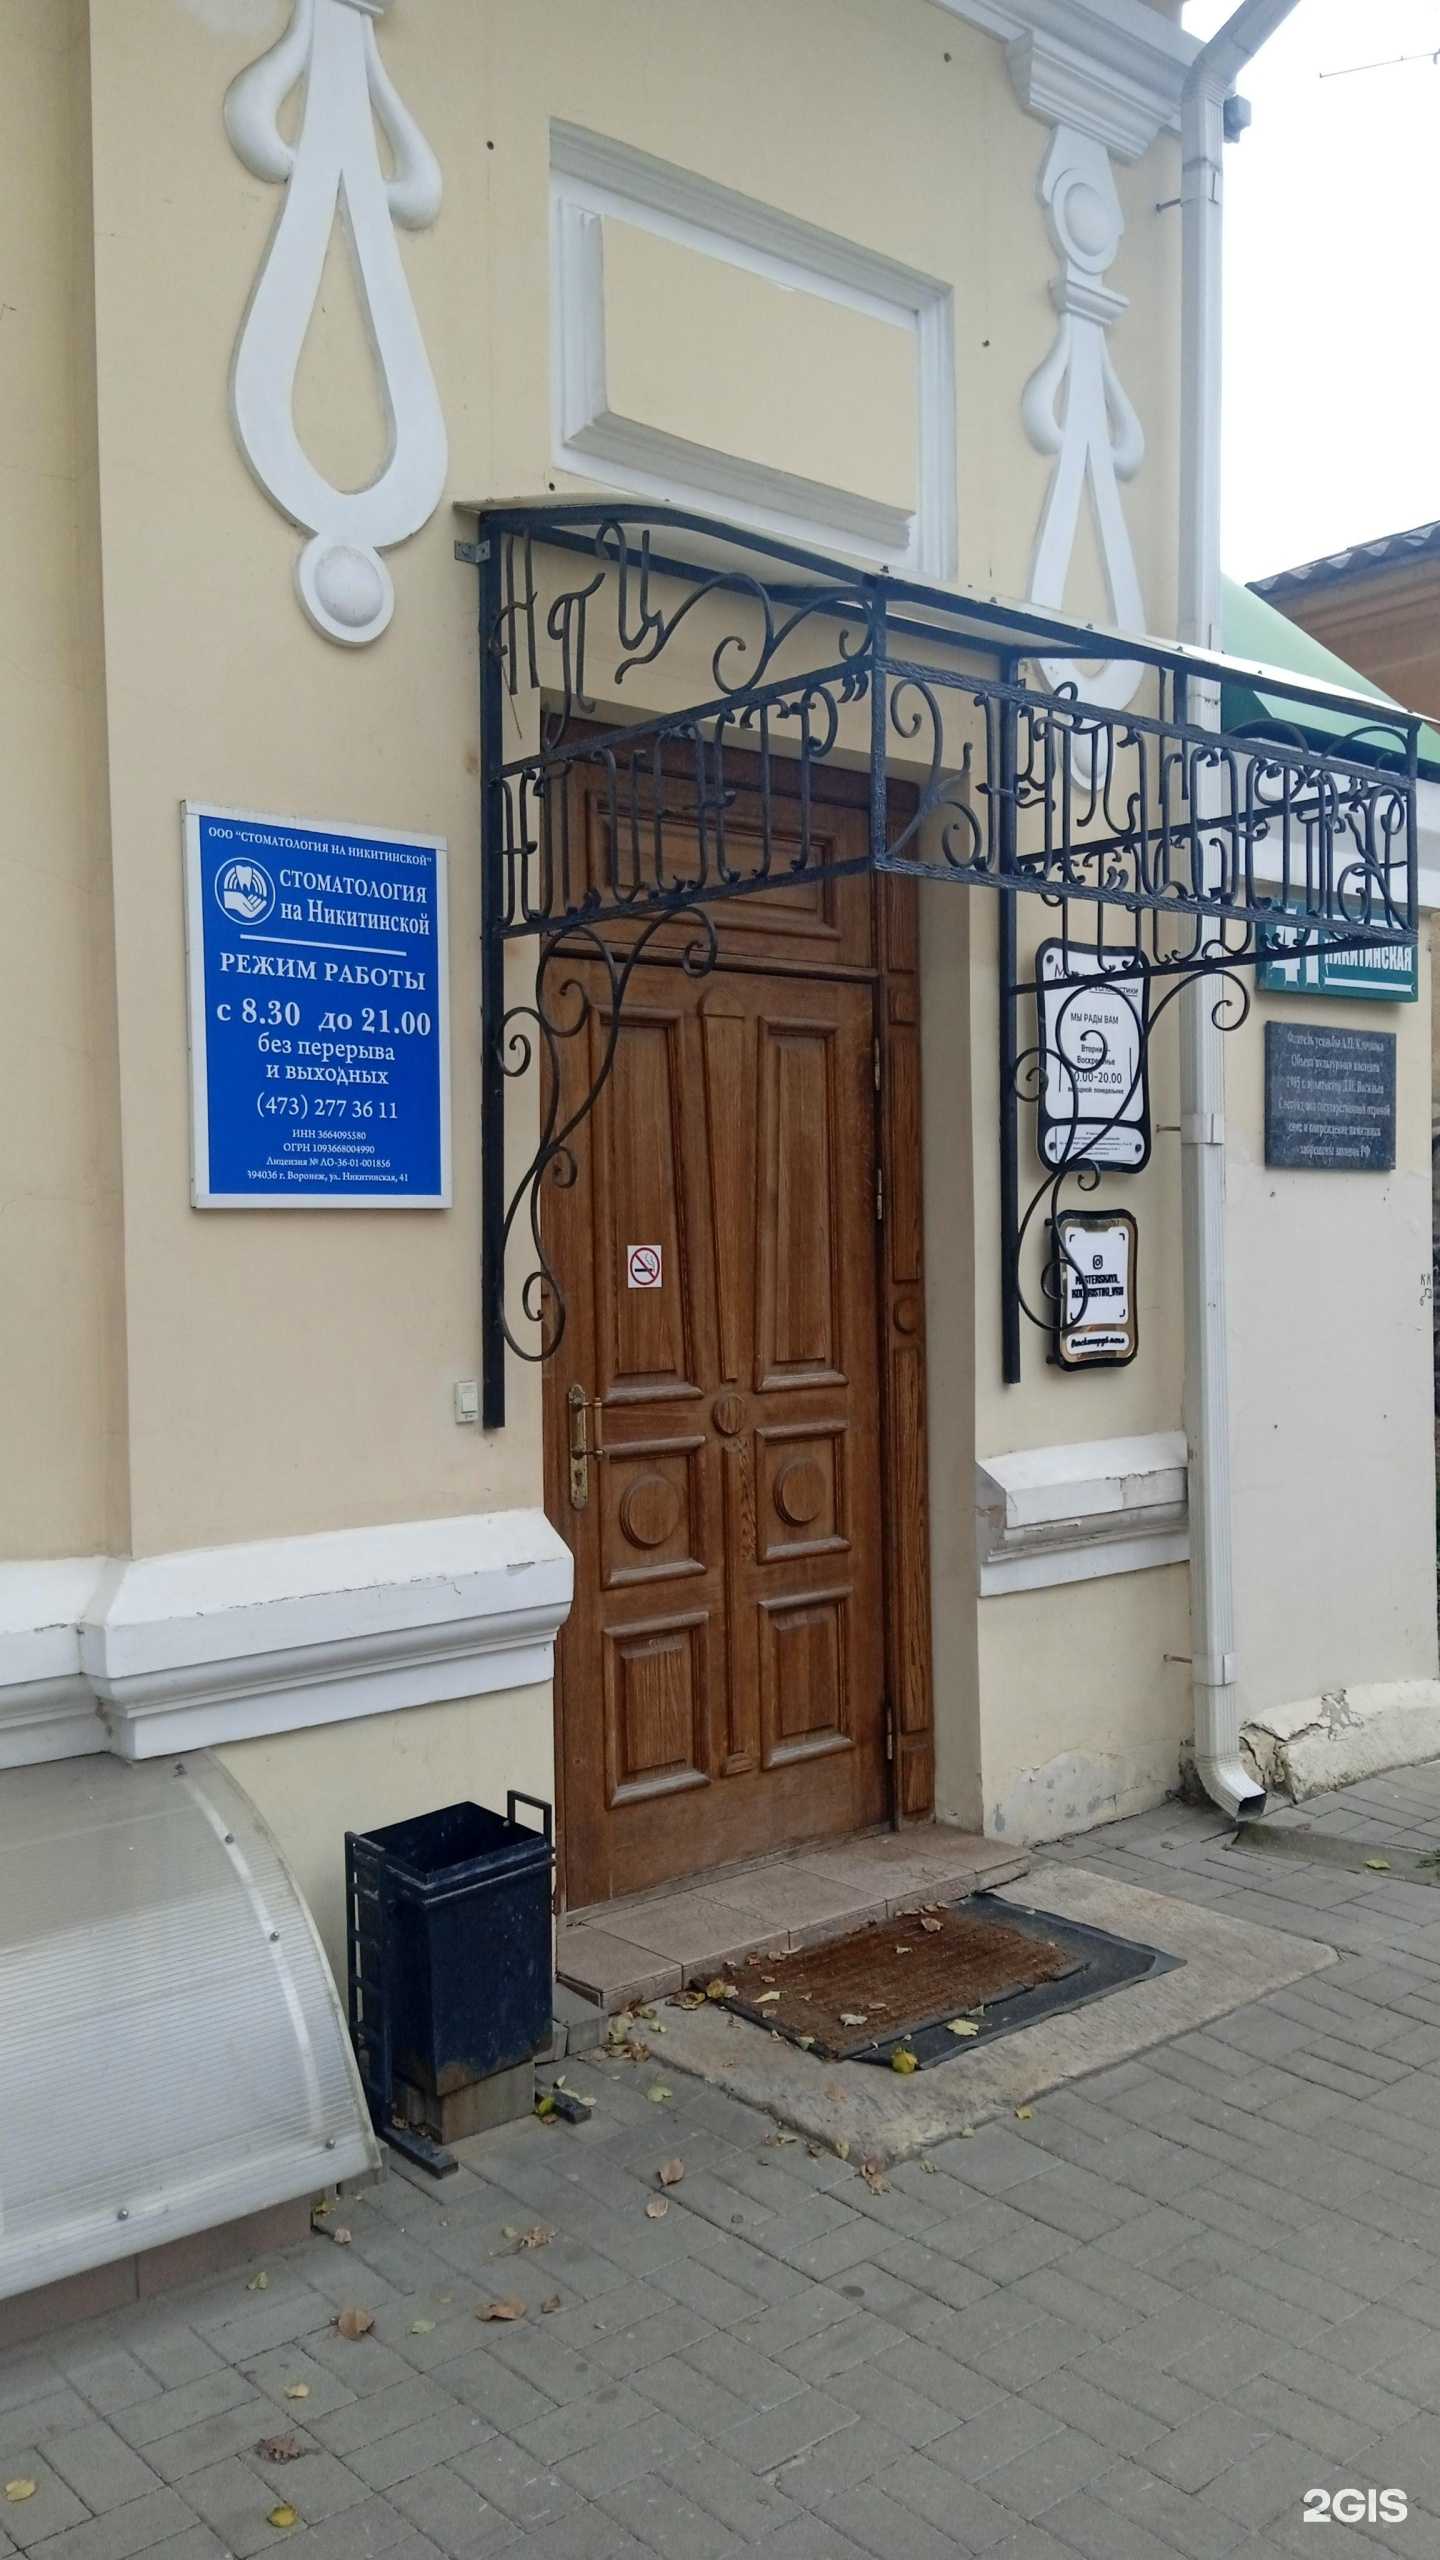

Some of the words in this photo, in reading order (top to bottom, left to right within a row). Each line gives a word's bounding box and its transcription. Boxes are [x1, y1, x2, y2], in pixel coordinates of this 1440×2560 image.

[208, 826, 234, 840] ООО
[331, 844, 346, 856] НА
[279, 868, 427, 903] СТОМАТОЛОГИЯ
[280, 902, 303, 921] на
[306, 899, 431, 936] Никитинской
[219, 952, 318, 981] РЕЖИМ
[323, 962, 426, 991] РАБОТЫ
[241, 997, 301, 1027] 8.30
[318, 1011, 353, 1033] до
[361, 1007, 432, 1036] 21.00
[1070, 1013, 1083, 1023] МЫ
[1084, 1014, 1103, 1025] РАДЫ
[1104, 1016, 1119, 1025] ВАМ
[258, 1031, 292, 1054] без
[297, 1040, 396, 1064] перерыва
[1081, 1044, 1106, 1053] Вторни
[266, 1064, 280, 1079] и
[286, 1065, 390, 1086] выходных
[1071, 1071, 1122, 1084] 0.00-20.00
[256, 1091, 308, 1120] (473)
[314, 1098, 347, 1119] 277
[351, 1099, 374, 1119] 36
[379, 1101, 399, 1120] 11
[292, 1129, 316, 1139] ИНН
[317, 1130, 367, 1141] 3664095580
[283, 1143, 311, 1153] ОГРН
[266, 1156, 308, 1166] Лицензия
[309, 1158, 319, 1167] №
[287, 1170, 328, 1182] Воронеж,
[399, 1173, 408, 1182] 41
